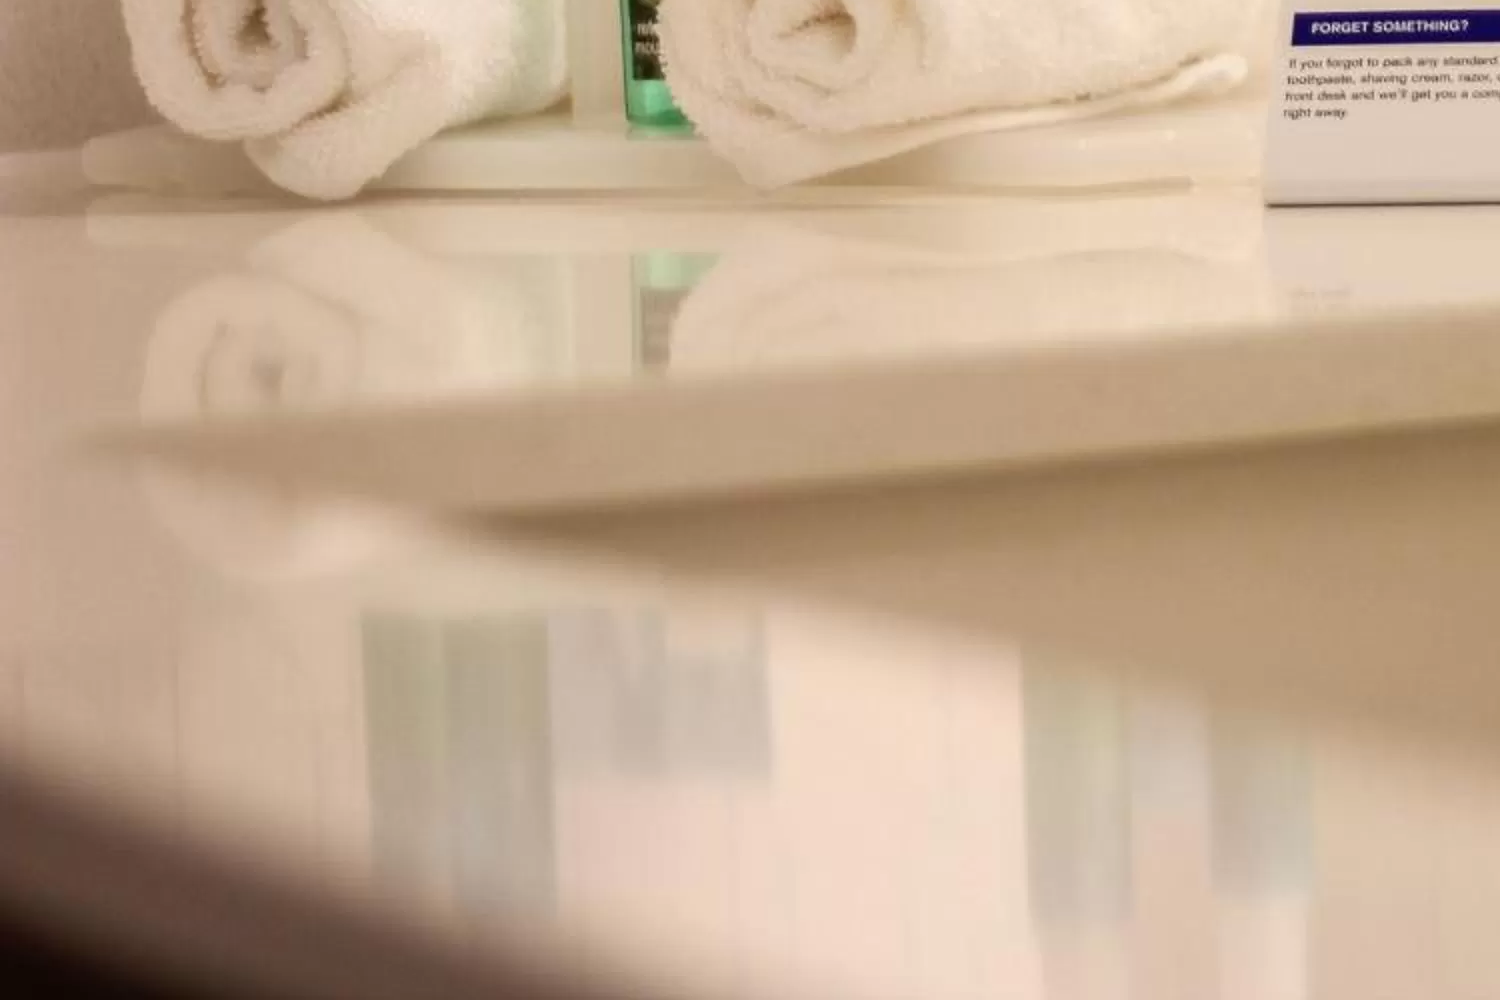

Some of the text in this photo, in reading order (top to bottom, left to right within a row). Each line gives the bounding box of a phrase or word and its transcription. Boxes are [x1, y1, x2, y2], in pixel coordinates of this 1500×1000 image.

[1311, 19, 1469, 35] FORGET SOMETHING?
[1288, 58, 1297, 69] If
[1300, 60, 1322, 70] you
[1325, 57, 1363, 70] forgot
[1367, 56, 1379, 67] to
[1382, 56, 1413, 68] pack
[1416, 58, 1438, 68] any
[1443, 55, 1498, 66] standard
[1287, 74, 1356, 86] toothpaste,
[1360, 73, 1407, 85] shaving
[1457, 74, 1492, 83] razor,
[1285, 91, 1313, 101] front
[1317, 90, 1346, 100] desk
[1350, 90, 1375, 100] and
[1411, 89, 1431, 101] get
[1435, 91, 1457, 101] you
[1283, 107, 1311, 120] right
